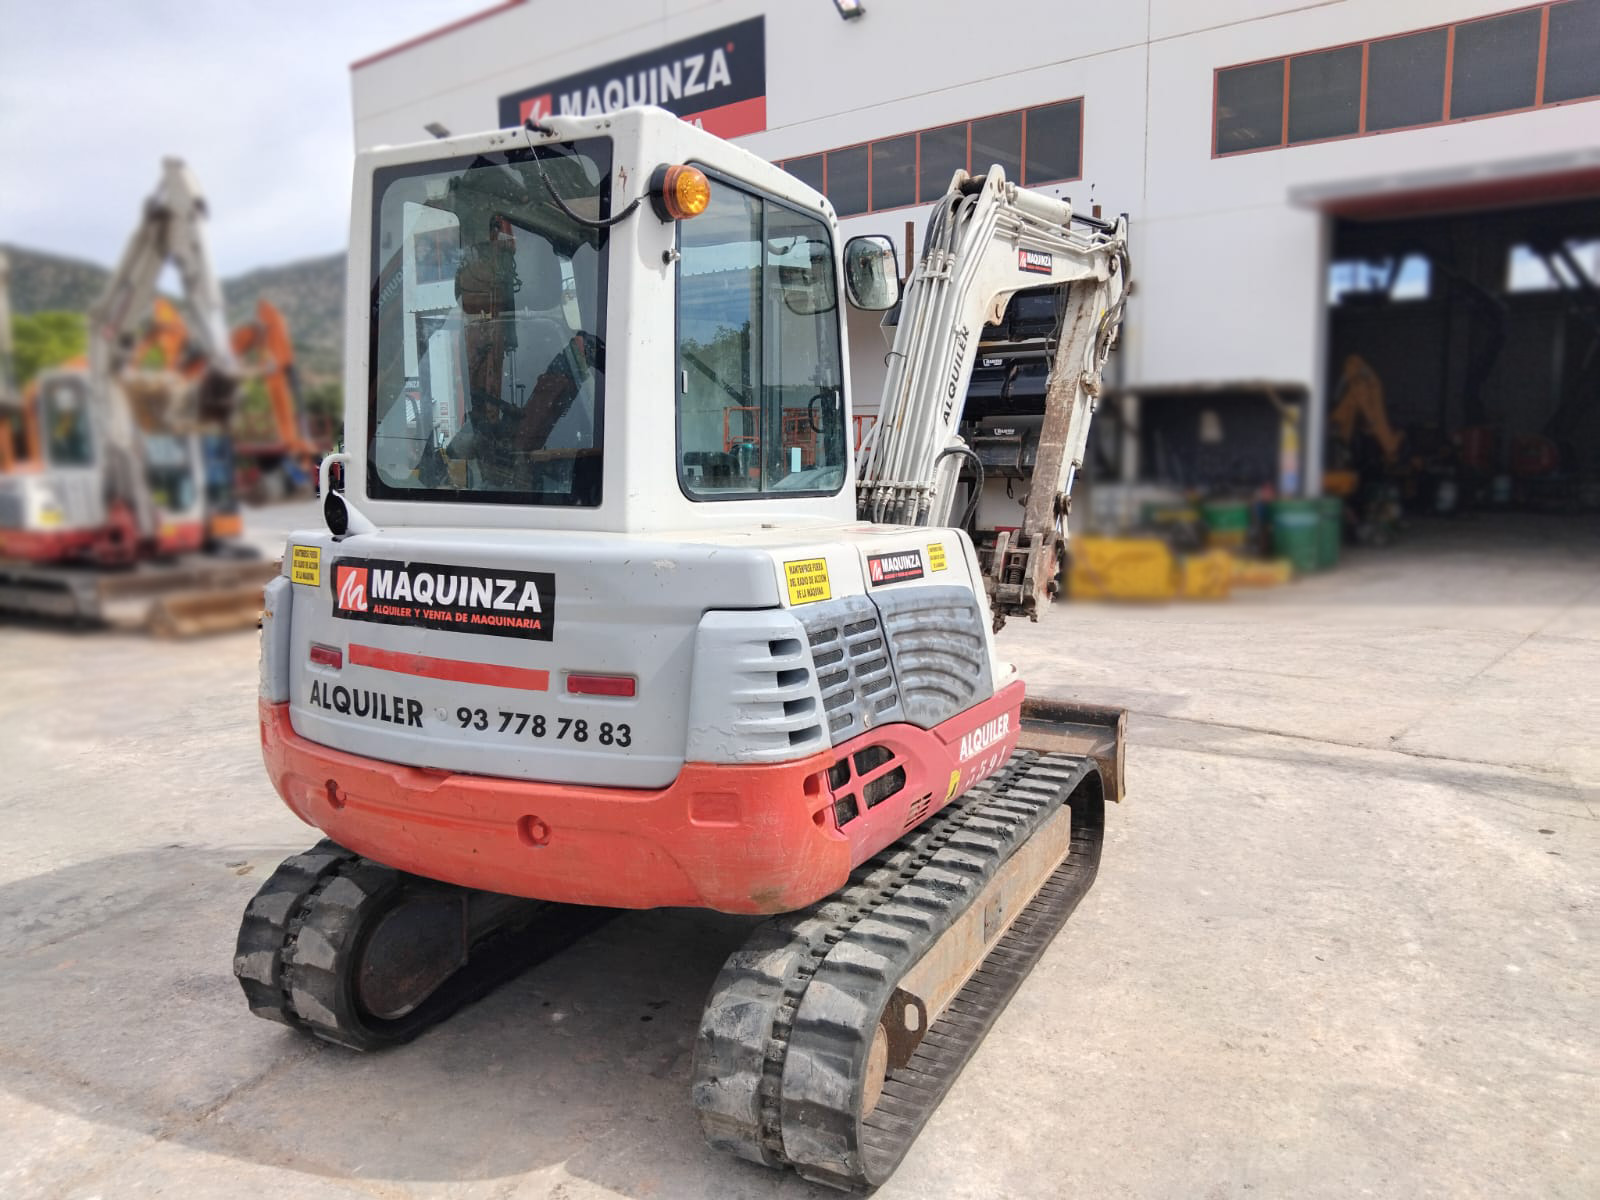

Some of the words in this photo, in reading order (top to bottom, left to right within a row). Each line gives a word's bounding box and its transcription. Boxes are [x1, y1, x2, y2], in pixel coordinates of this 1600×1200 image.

[560, 48, 731, 117] MAQUINZA
[943, 326, 969, 426] ALQUILER
[881, 554, 921, 573] MAQUINZA
[371, 569, 542, 613] MAQUINZA
[373, 604, 411, 617] ALQUILER
[414, 609, 421, 617] Y
[423, 610, 452, 621] VENTA
[455, 613, 468, 623] DE
[471, 614, 541, 629] MAQUINARIA
[309, 679, 424, 728] ALQUILER
[456, 707, 489, 731] 93
[498, 711, 547, 738] 778
[556, 717, 588, 742] 78
[599, 721, 632, 748] 83
[960, 713, 1010, 761] ALQUILER
